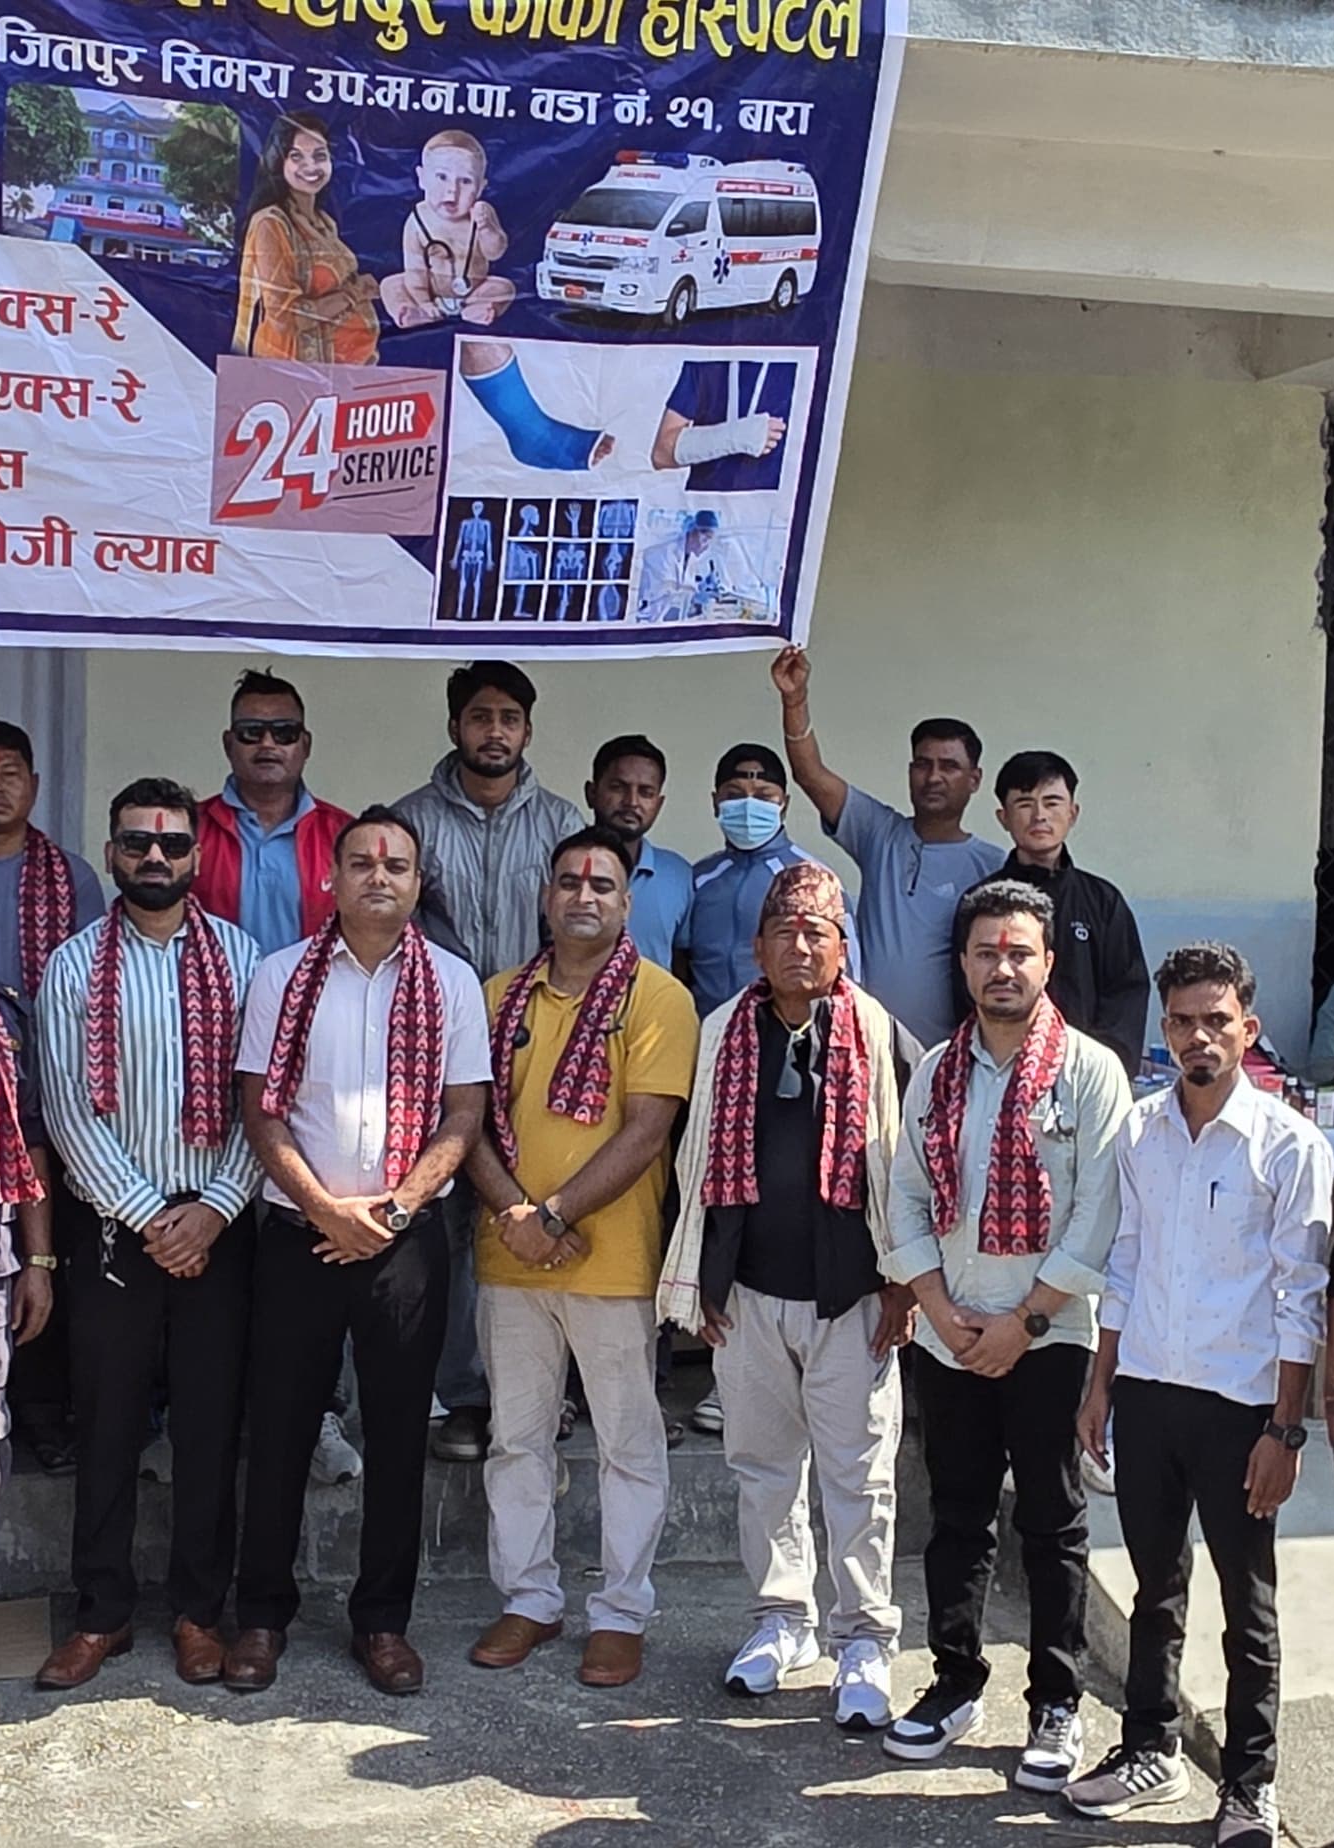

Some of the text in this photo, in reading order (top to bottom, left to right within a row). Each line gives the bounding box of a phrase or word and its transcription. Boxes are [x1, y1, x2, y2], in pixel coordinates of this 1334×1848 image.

[161, 39, 294, 98] सिमरा
[530, 87, 602, 126] वडा
[739, 98, 814, 135] बारा
[347, 400, 415, 440] HOUR
[219, 394, 341, 515] 24
[342, 445, 437, 485] SERVICE
[93, 531, 221, 575] ल्याब
